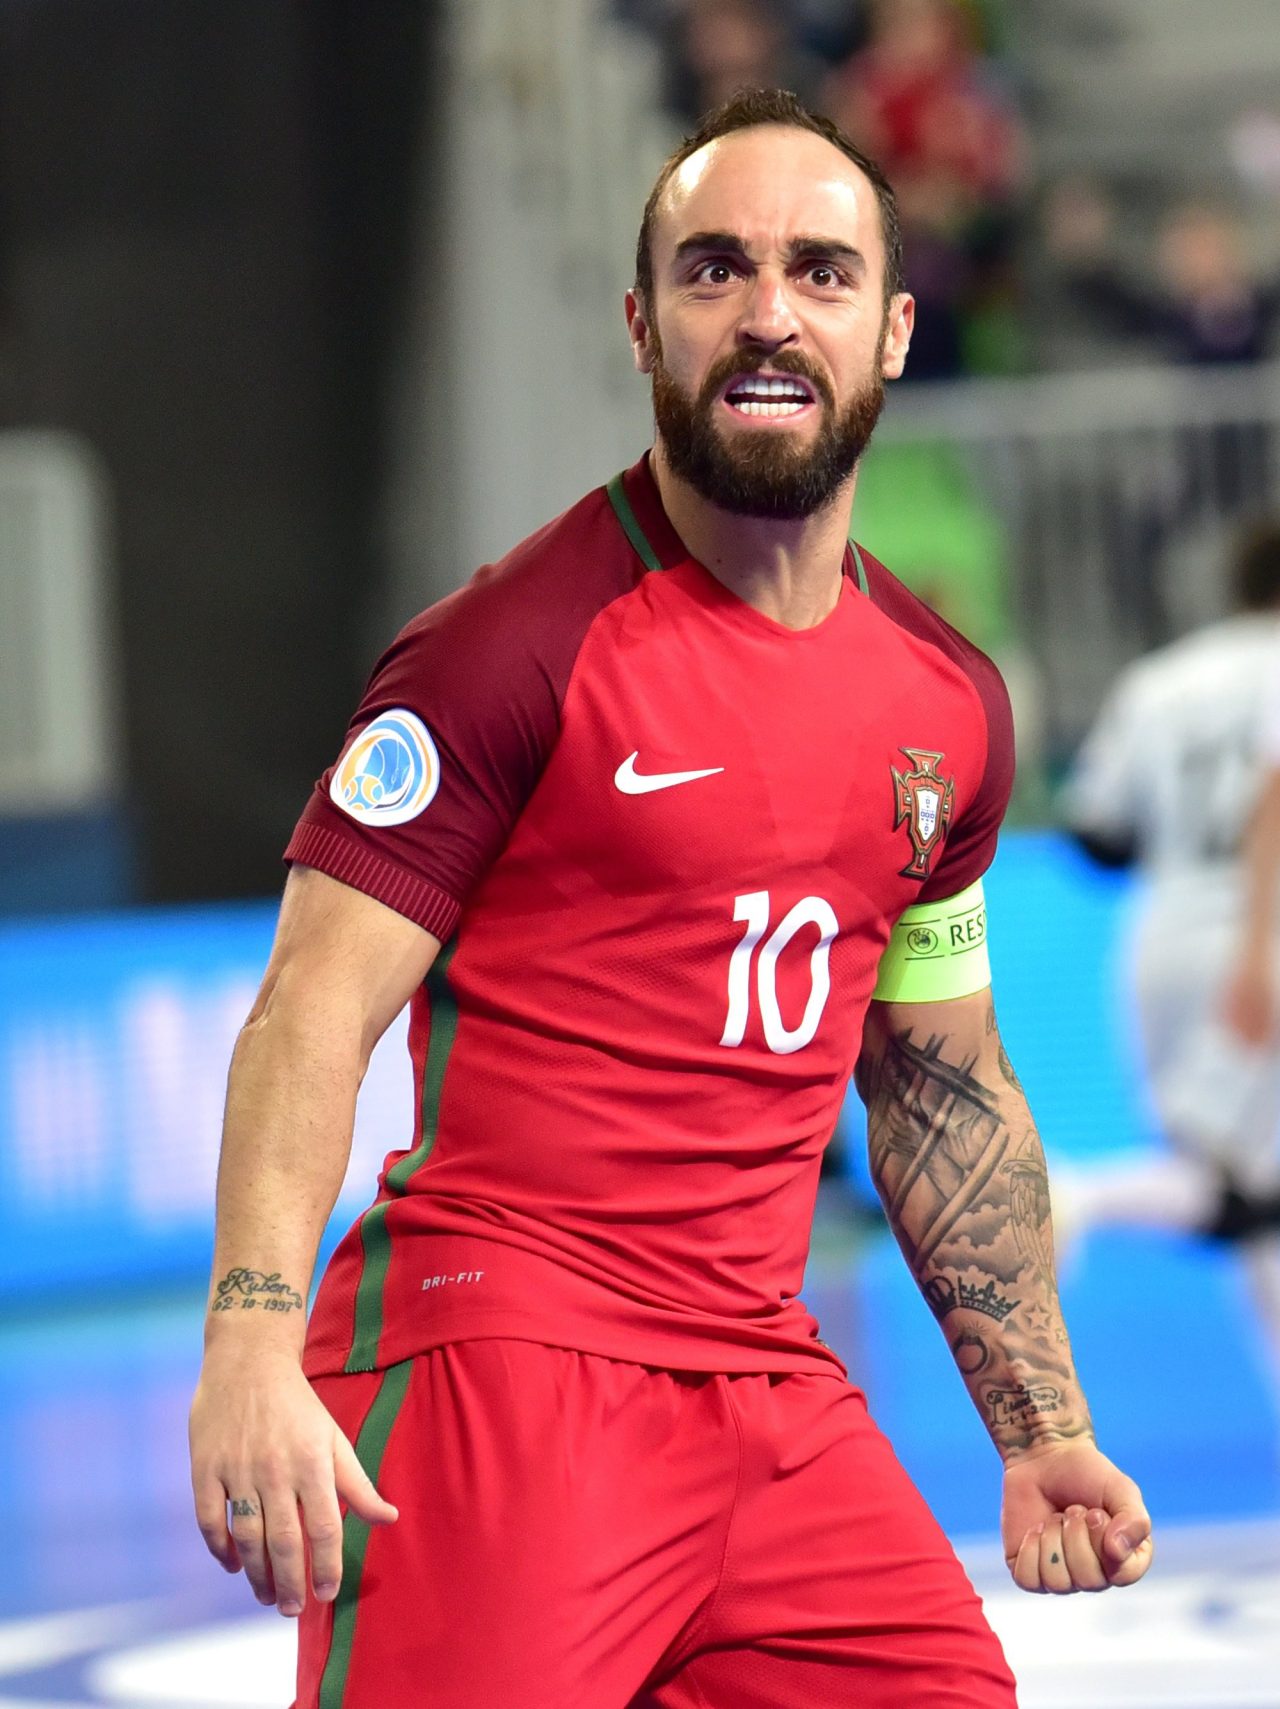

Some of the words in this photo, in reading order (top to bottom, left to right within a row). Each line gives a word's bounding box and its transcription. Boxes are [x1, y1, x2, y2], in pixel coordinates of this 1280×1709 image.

[950, 909, 986, 947] RES
[719, 890, 839, 1055] 10
[421, 1271, 485, 1291] DRI-FIT
